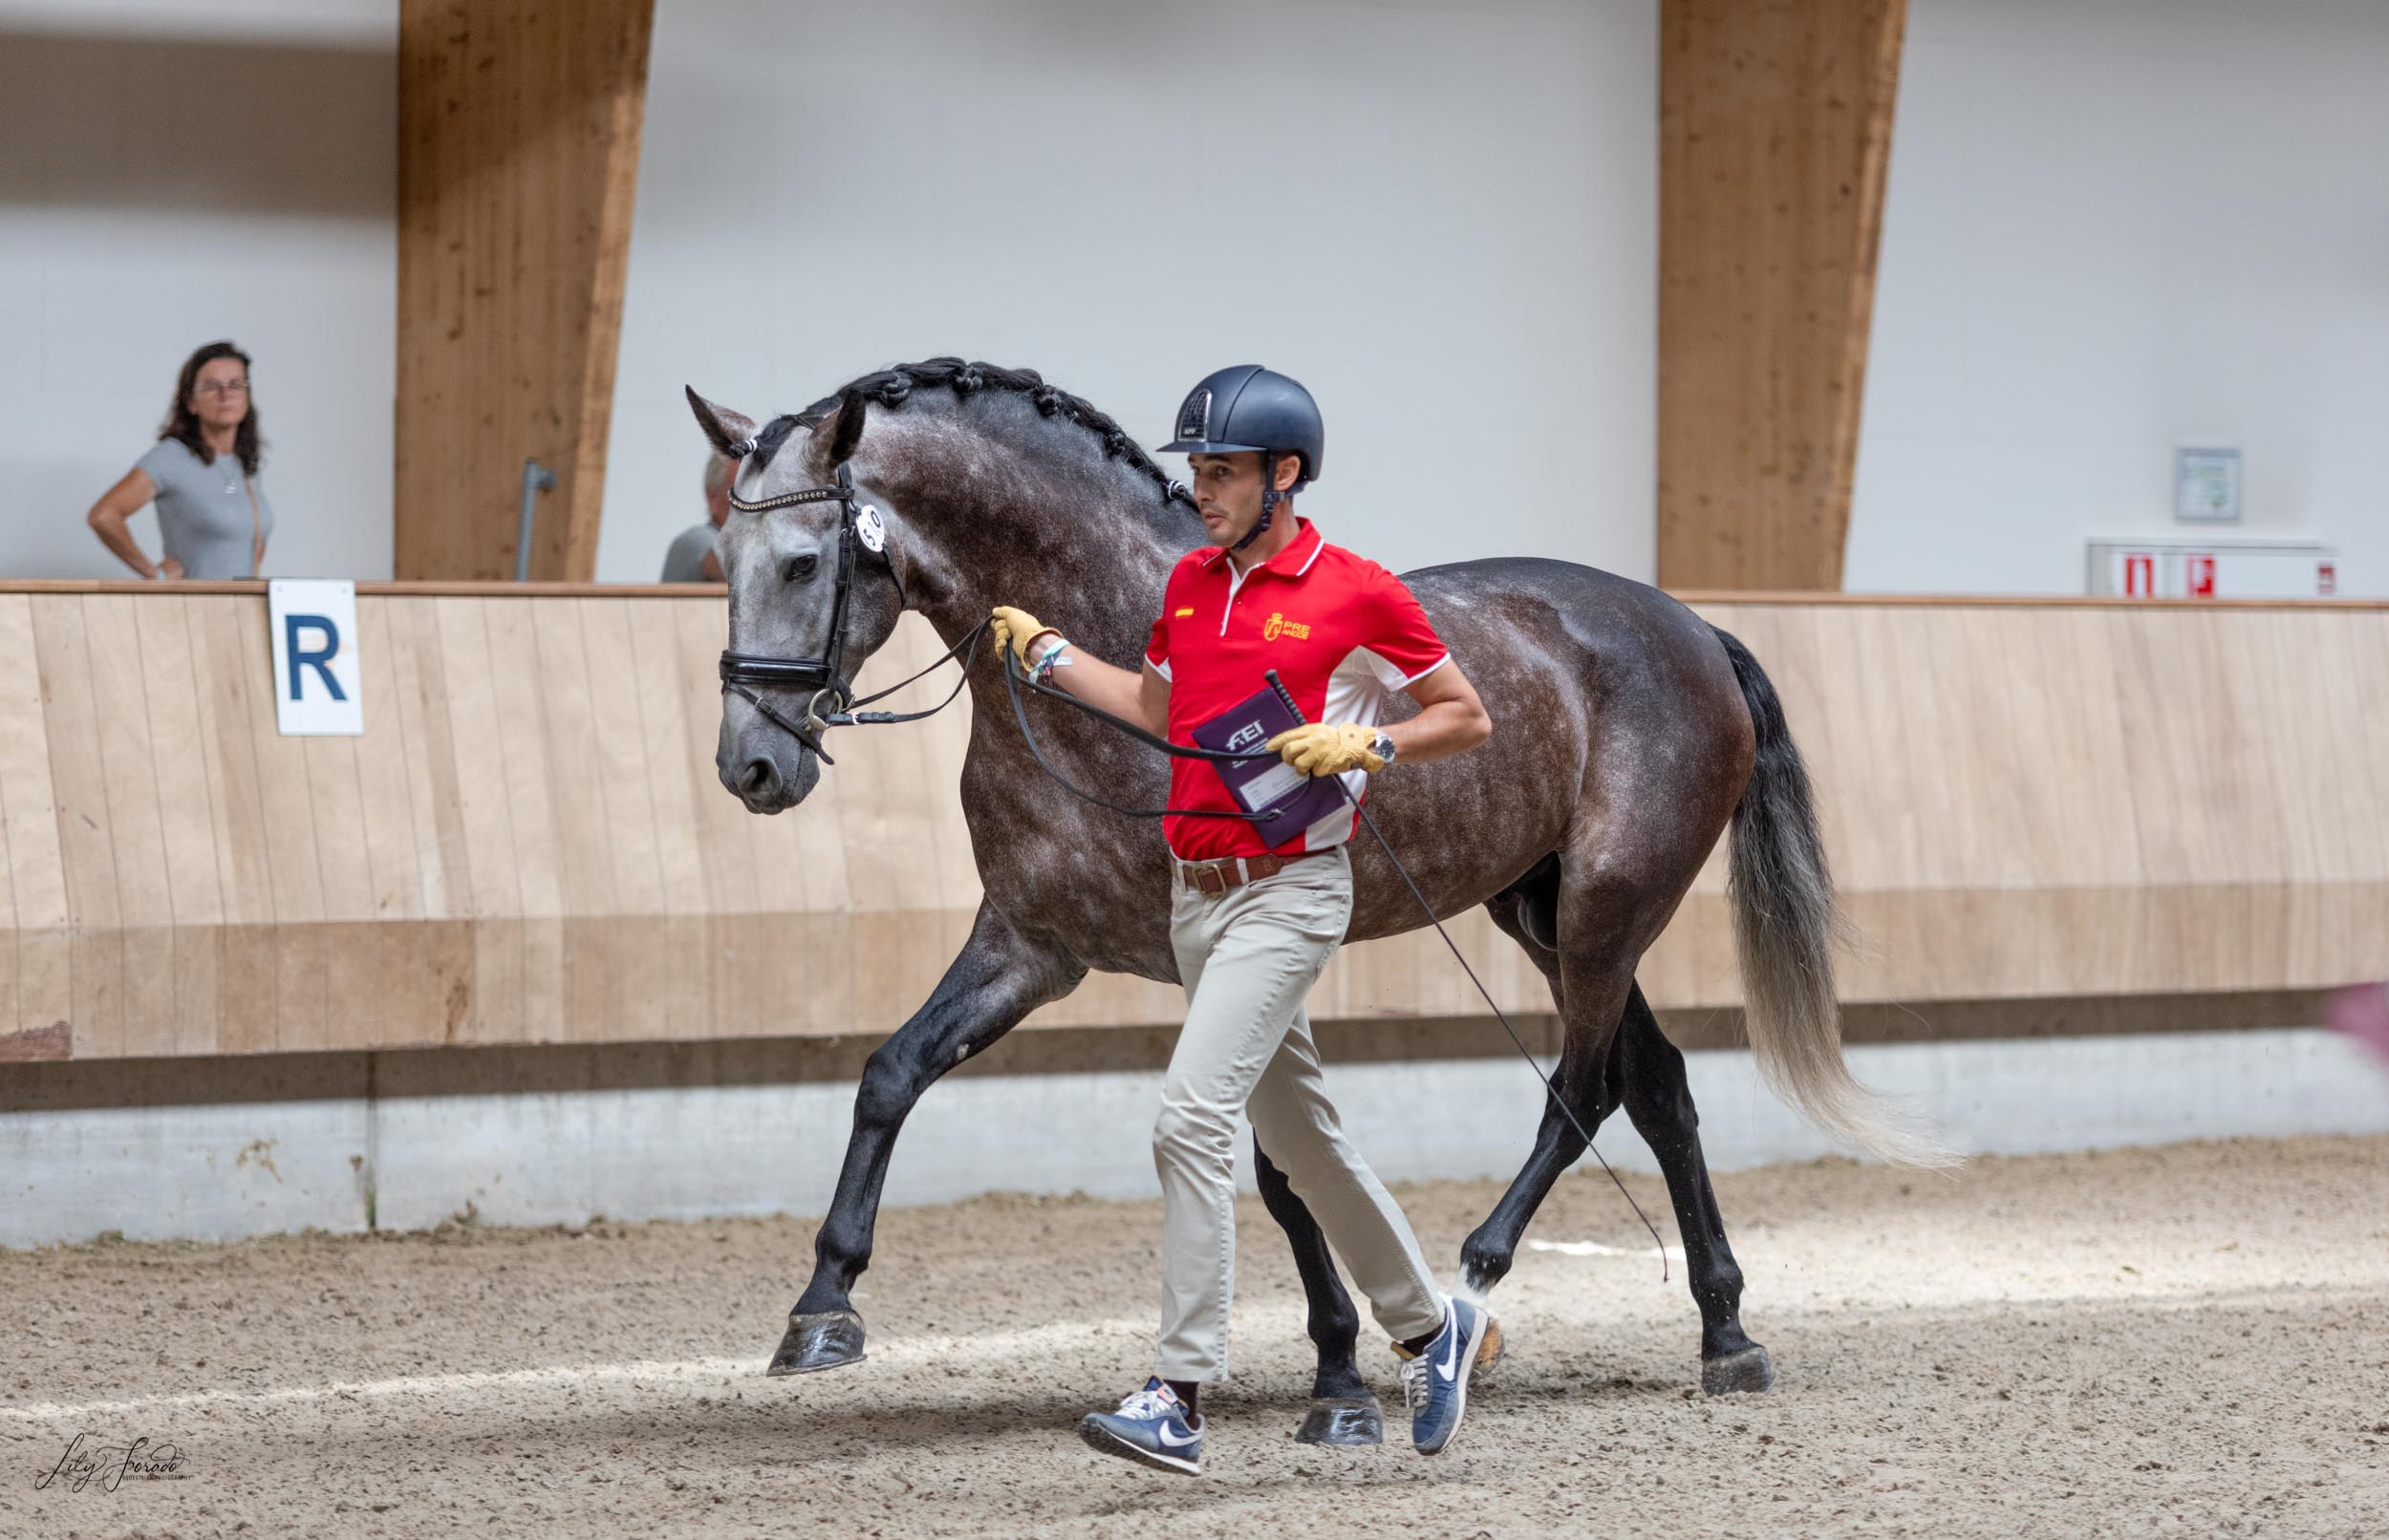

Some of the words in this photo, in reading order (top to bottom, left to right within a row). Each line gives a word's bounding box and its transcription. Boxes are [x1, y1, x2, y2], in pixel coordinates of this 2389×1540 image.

[1283, 620, 1311, 631] PRE
[285, 614, 348, 701] R
[1226, 720, 1264, 750] FEI
